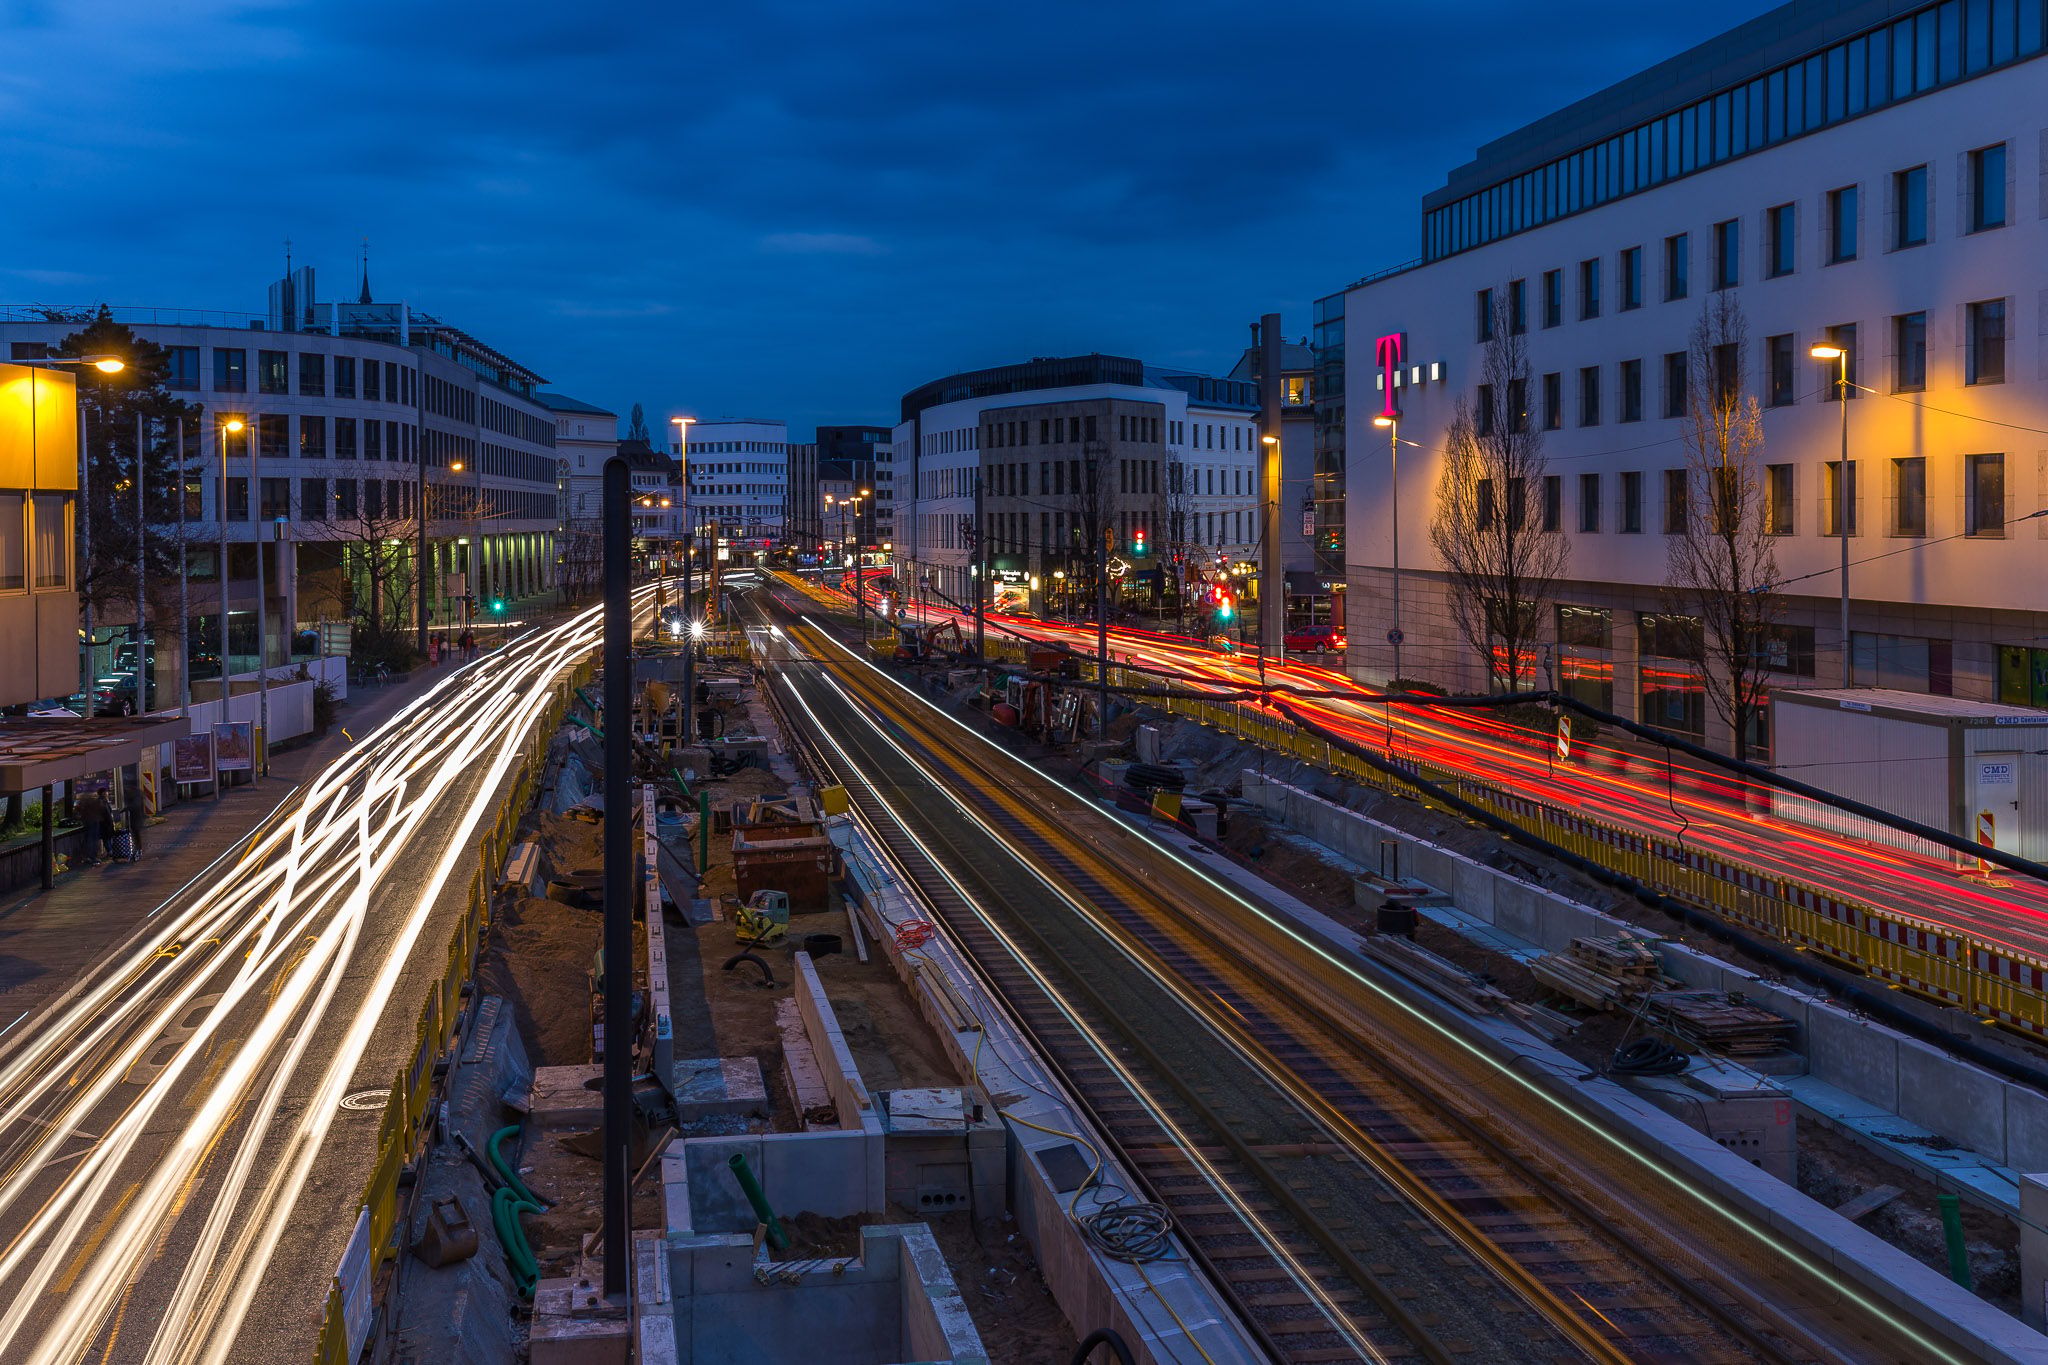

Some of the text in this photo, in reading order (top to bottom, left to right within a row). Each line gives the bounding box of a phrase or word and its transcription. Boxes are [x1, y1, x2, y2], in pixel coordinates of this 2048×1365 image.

[1376, 333, 1401, 416] T
[1997, 716, 2019, 724] CMD
[1983, 765, 2008, 774] CMD
[1775, 1100, 1792, 1125] B
